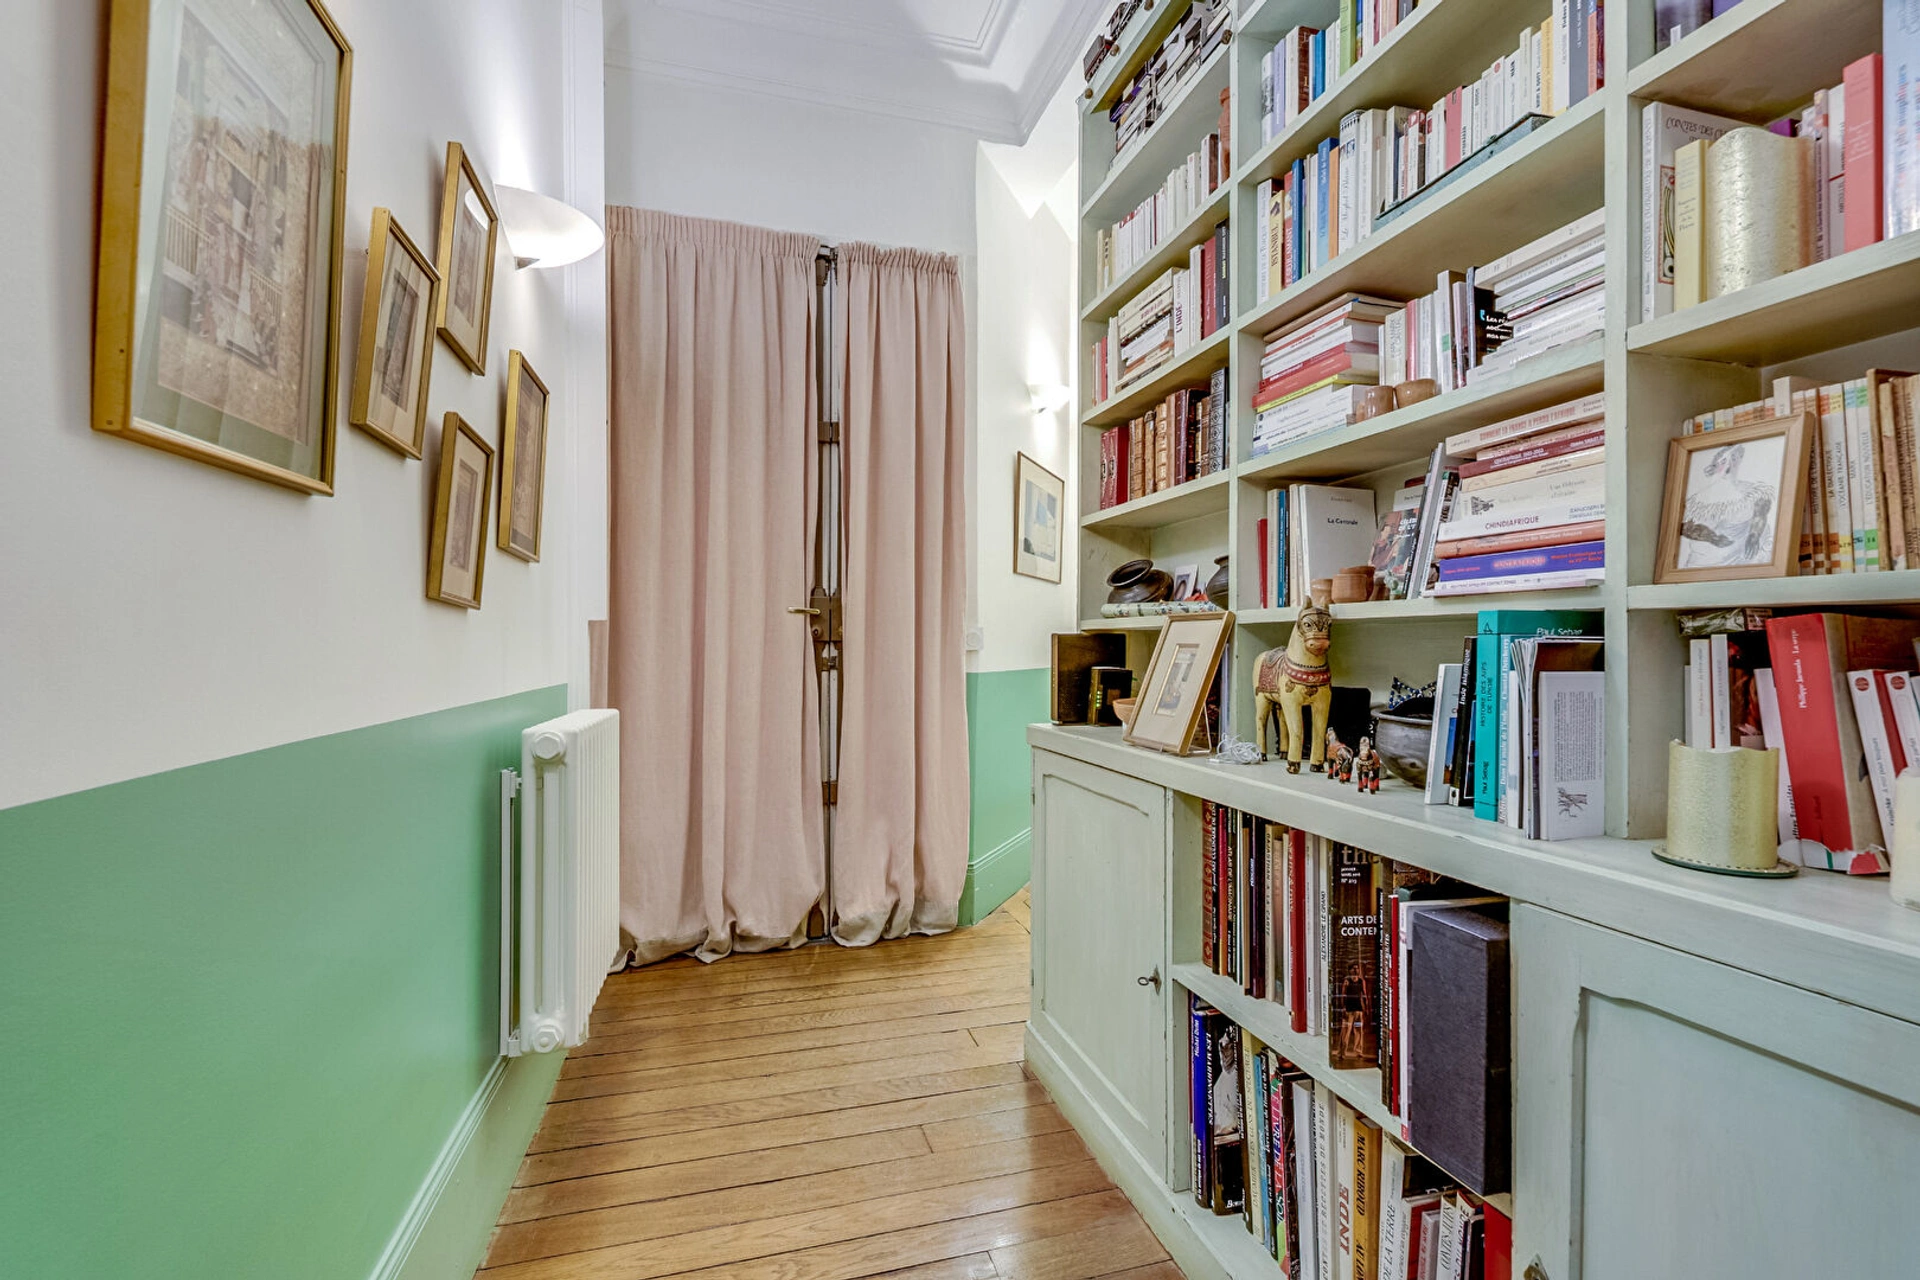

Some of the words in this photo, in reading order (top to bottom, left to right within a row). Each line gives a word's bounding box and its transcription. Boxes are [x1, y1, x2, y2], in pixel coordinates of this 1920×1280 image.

[1270, 225, 1279, 267] ISTANBUL
[1175, 303, 1184, 333] L'INDE
[1835, 441, 1845, 474] FRANÇAISE
[1862, 431, 1871, 463] NOUVELLE
[1825, 449, 1834, 488] DIALECTIQUE
[1827, 489, 1835, 498] LA
[1485, 515, 1540, 530] CHINDIAFRIQUE
[1792, 644, 1799, 654] La
[1793, 658, 1804, 682] Jaenada
[1459, 686, 1468, 705] Inde
[1797, 683, 1807, 708] Philippe
[1486, 704, 1493, 714] DE
[1501, 731, 1507, 740] de
[1871, 737, 1882, 761] toujours
[1481, 760, 1489, 781] Sebag
[1877, 762, 1886, 775] pour
[1227, 868, 1233, 877] DE
[1341, 915, 1364, 925] ARTS
[1243, 1044, 1252, 1091] SPECTACLE
[1206, 1048, 1214, 1125] MARIONNETTES
[1271, 1085, 1280, 1103] LE
[1246, 1097, 1253, 1115] DU
[1272, 1107, 1281, 1145] LIVRE
[1318, 1104, 1326, 1141] MONDE
[1273, 1148, 1282, 1167] DE
[1319, 1143, 1326, 1158] DU
[1356, 1132, 1366, 1171] MARC
[1250, 1165, 1258, 1207] DAUMIER
[1274, 1170, 1283, 1191] LA
[1320, 1163, 1328, 1218] RECETTES
[1356, 1171, 1366, 1216] RIBOUD
[1339, 1184, 1350, 1255] INDE
[1383, 1201, 1396, 1244] TERRE
[1456, 1205, 1470, 1245] MONDE
[1356, 1241, 1365, 1257] AU
[1383, 1245, 1394, 1262] LA
[1439, 1234, 1451, 1270] CONTES
[1356, 1258, 1364, 1280] LON
